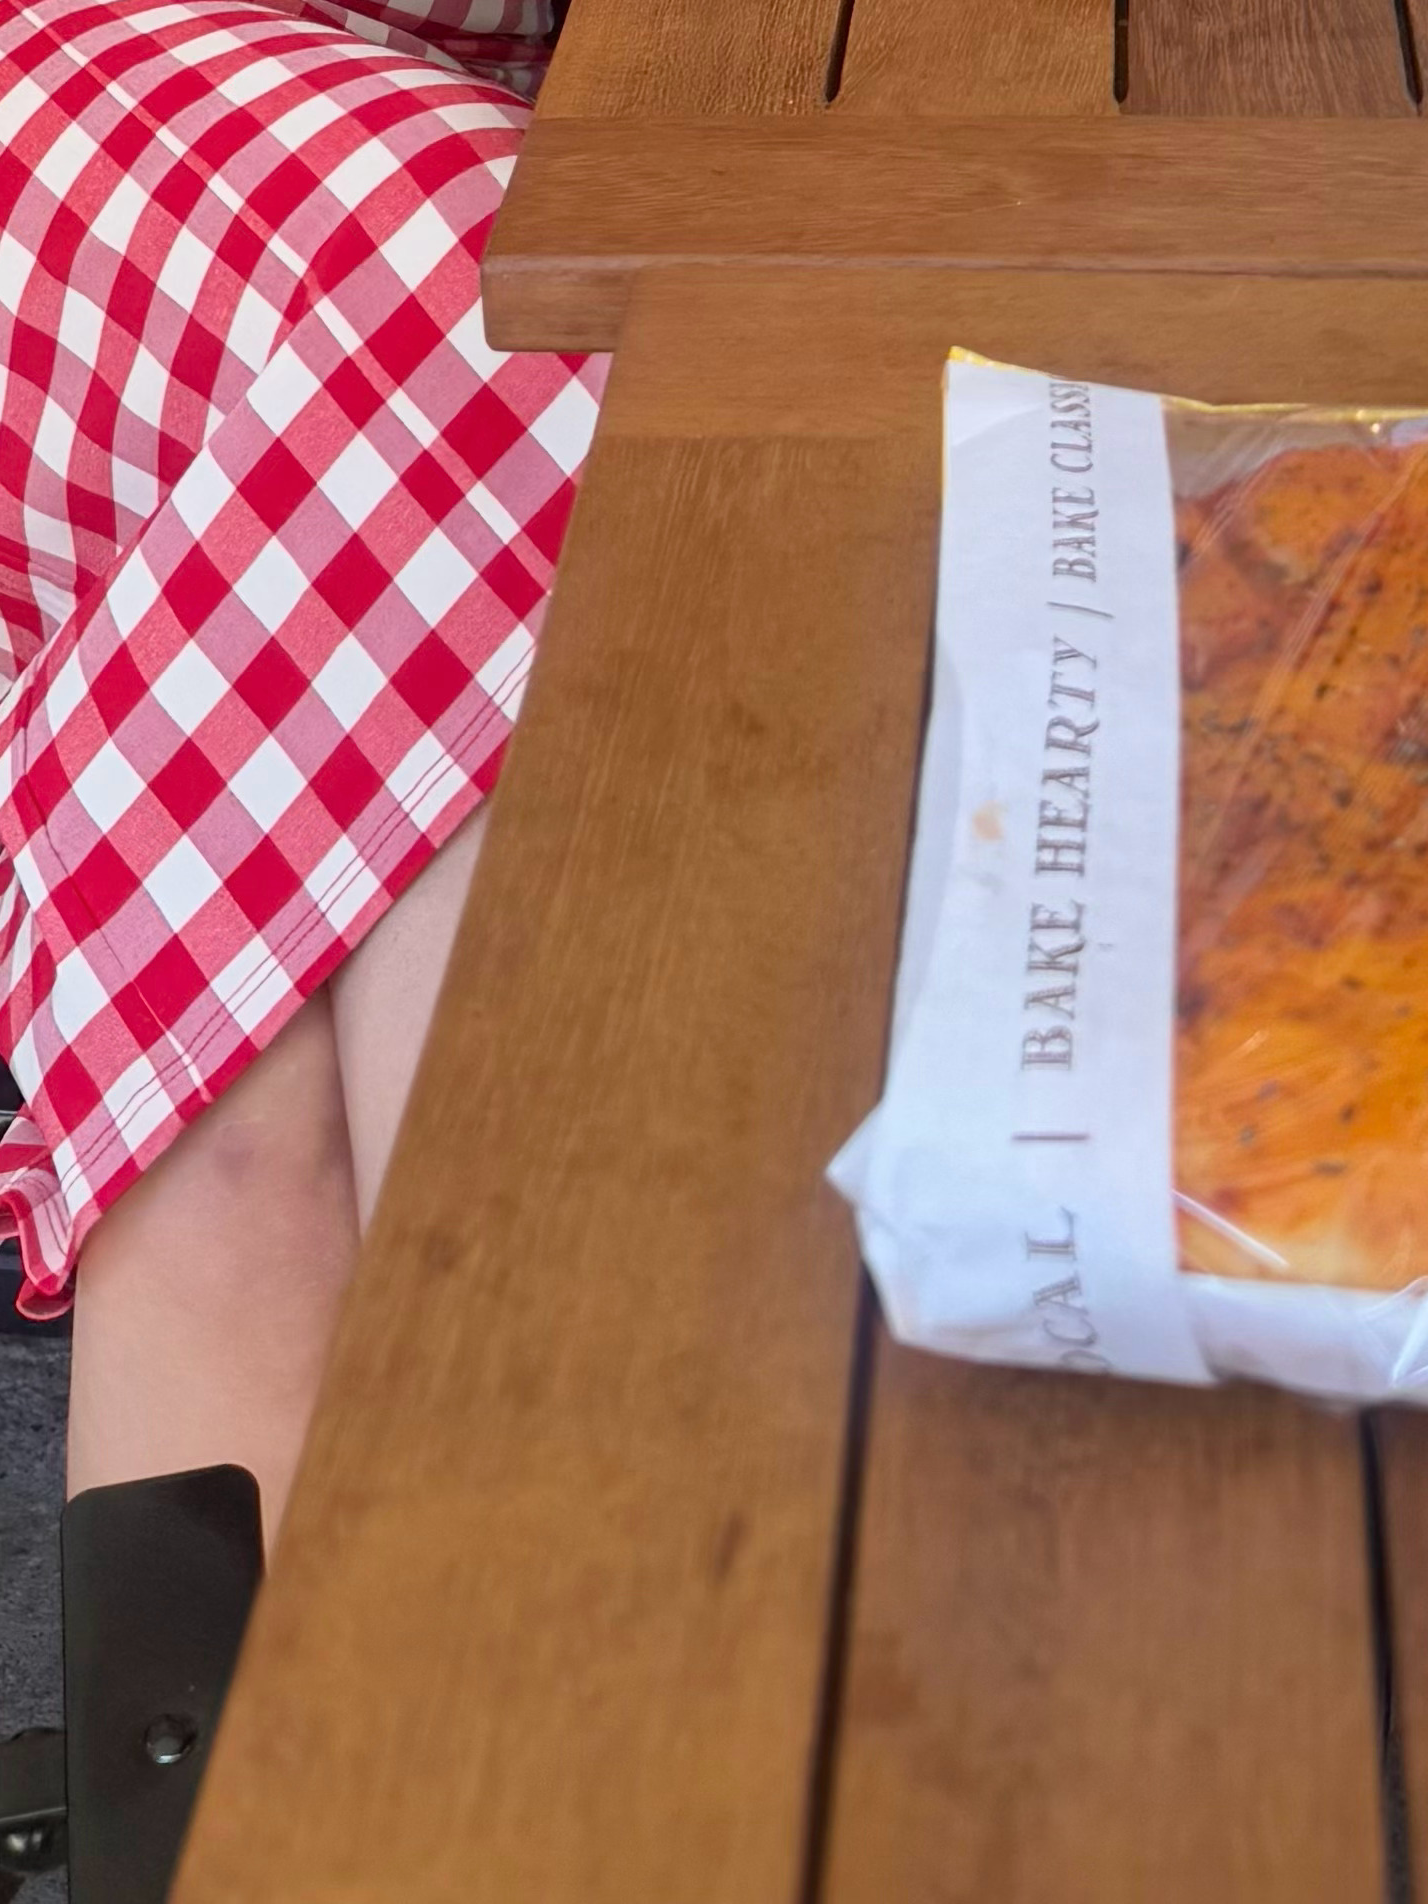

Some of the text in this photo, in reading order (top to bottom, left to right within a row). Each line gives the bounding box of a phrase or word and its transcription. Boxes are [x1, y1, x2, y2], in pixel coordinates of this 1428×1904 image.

[1052, 486, 1099, 583] BAKE
[1035, 635, 1100, 877] HEARTY
[1022, 898, 1086, 1071] BAKE
